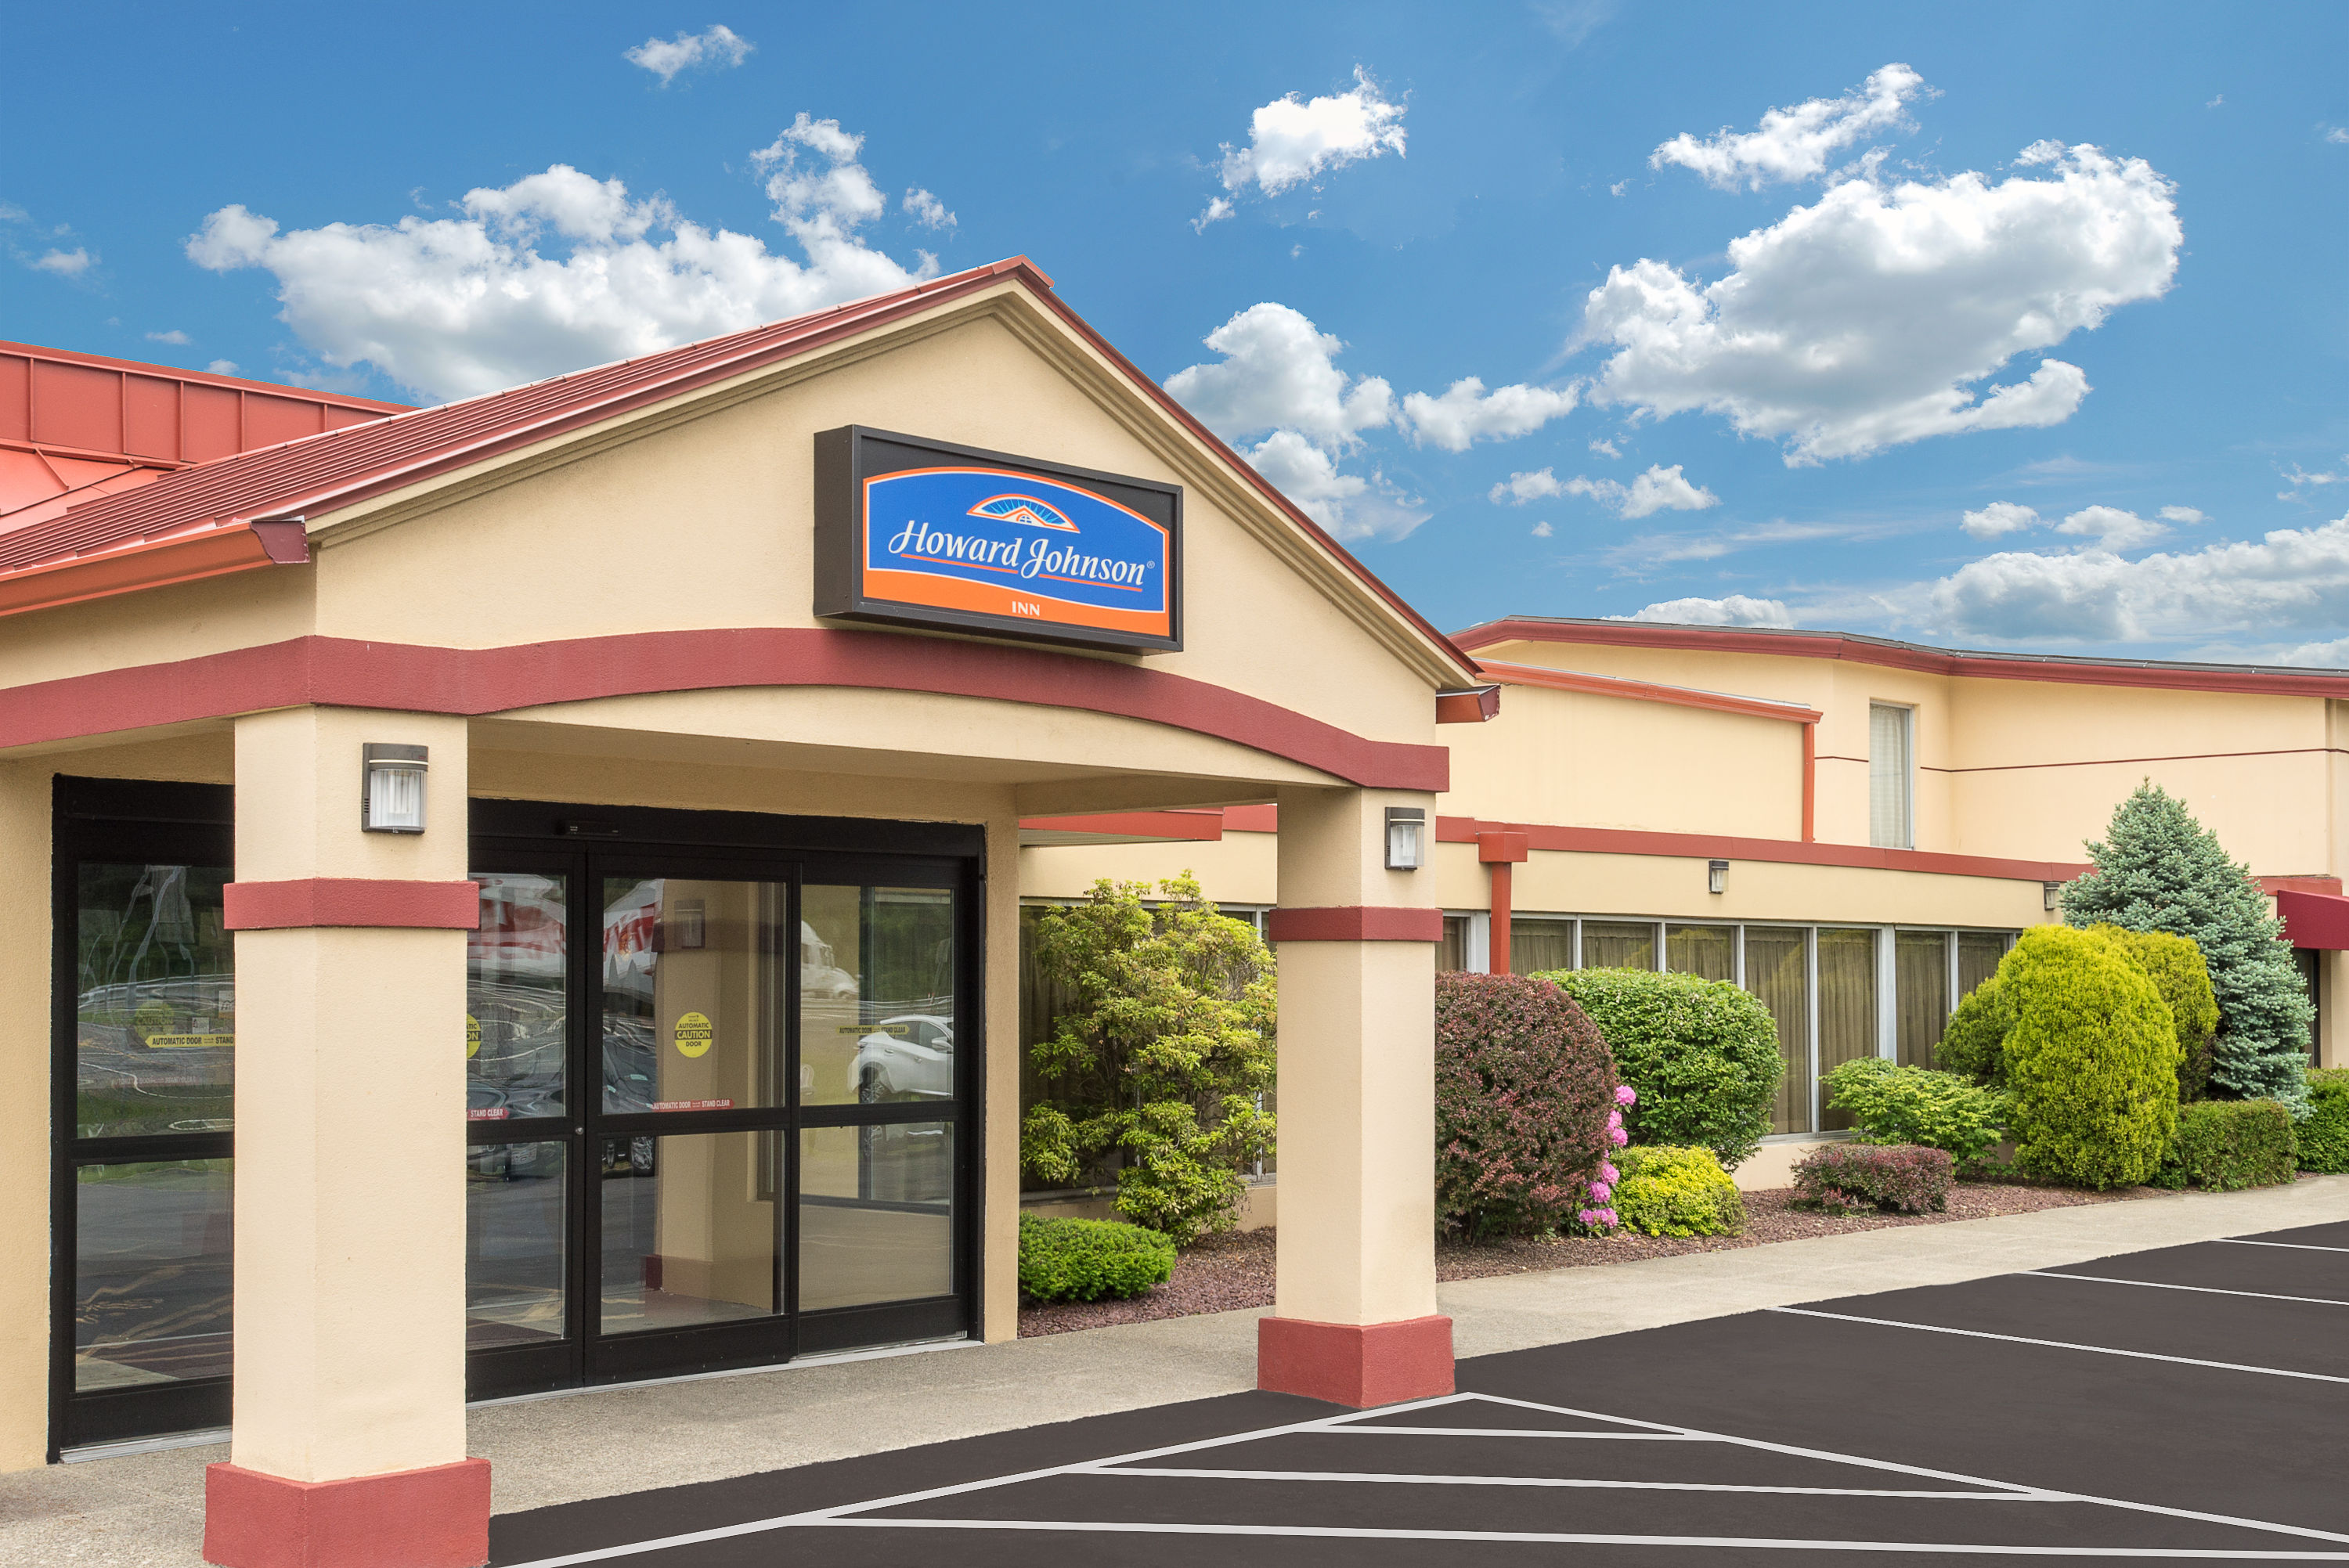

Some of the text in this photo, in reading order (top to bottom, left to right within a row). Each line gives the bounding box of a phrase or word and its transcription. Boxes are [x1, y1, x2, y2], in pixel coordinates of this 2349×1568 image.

[888, 520, 1019, 568] Howard
[1012, 600, 1041, 617] INN
[677, 1030, 711, 1039] CAUTION
[653, 1101, 679, 1110] AUTOMATIC
